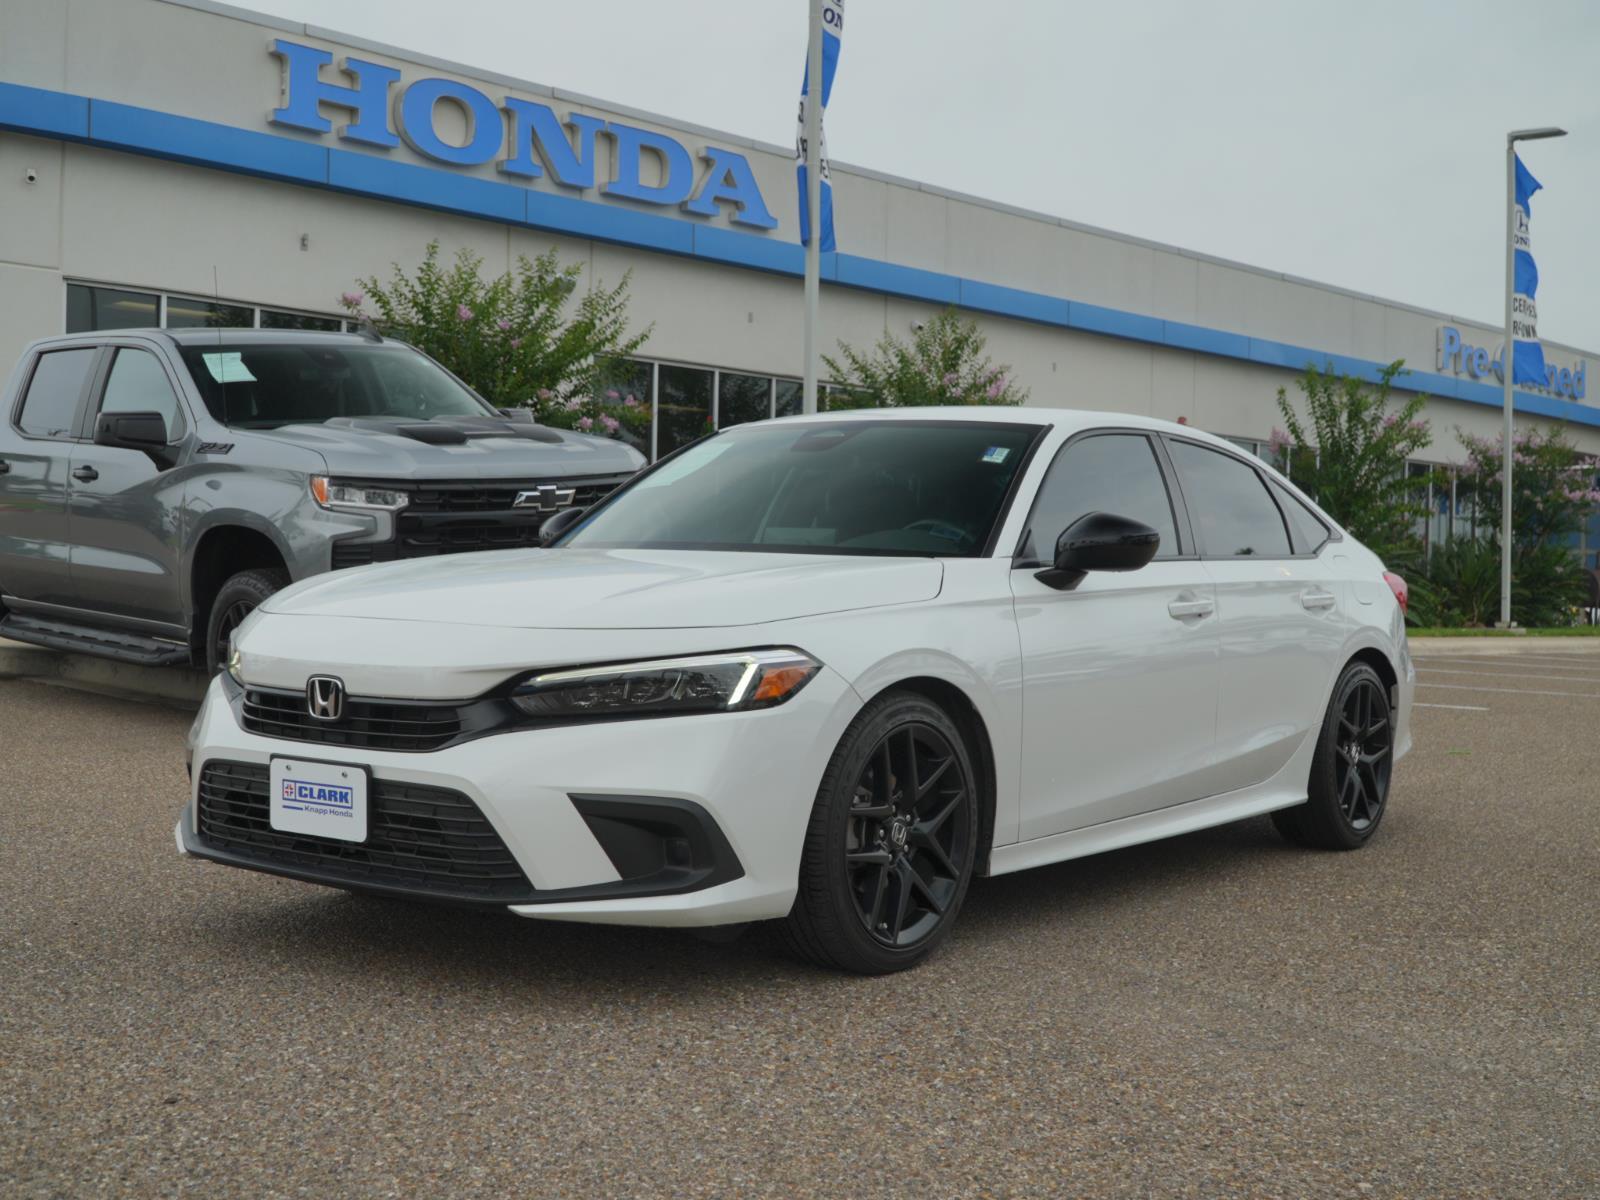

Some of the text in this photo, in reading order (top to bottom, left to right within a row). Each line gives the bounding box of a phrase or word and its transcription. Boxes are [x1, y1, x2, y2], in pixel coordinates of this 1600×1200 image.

[267, 38, 778, 230] HONDA
[1437, 325, 1586, 400] Pre-ned
[298, 786, 349, 804] CLARK
[304, 804, 353, 818] Knapp Honda
